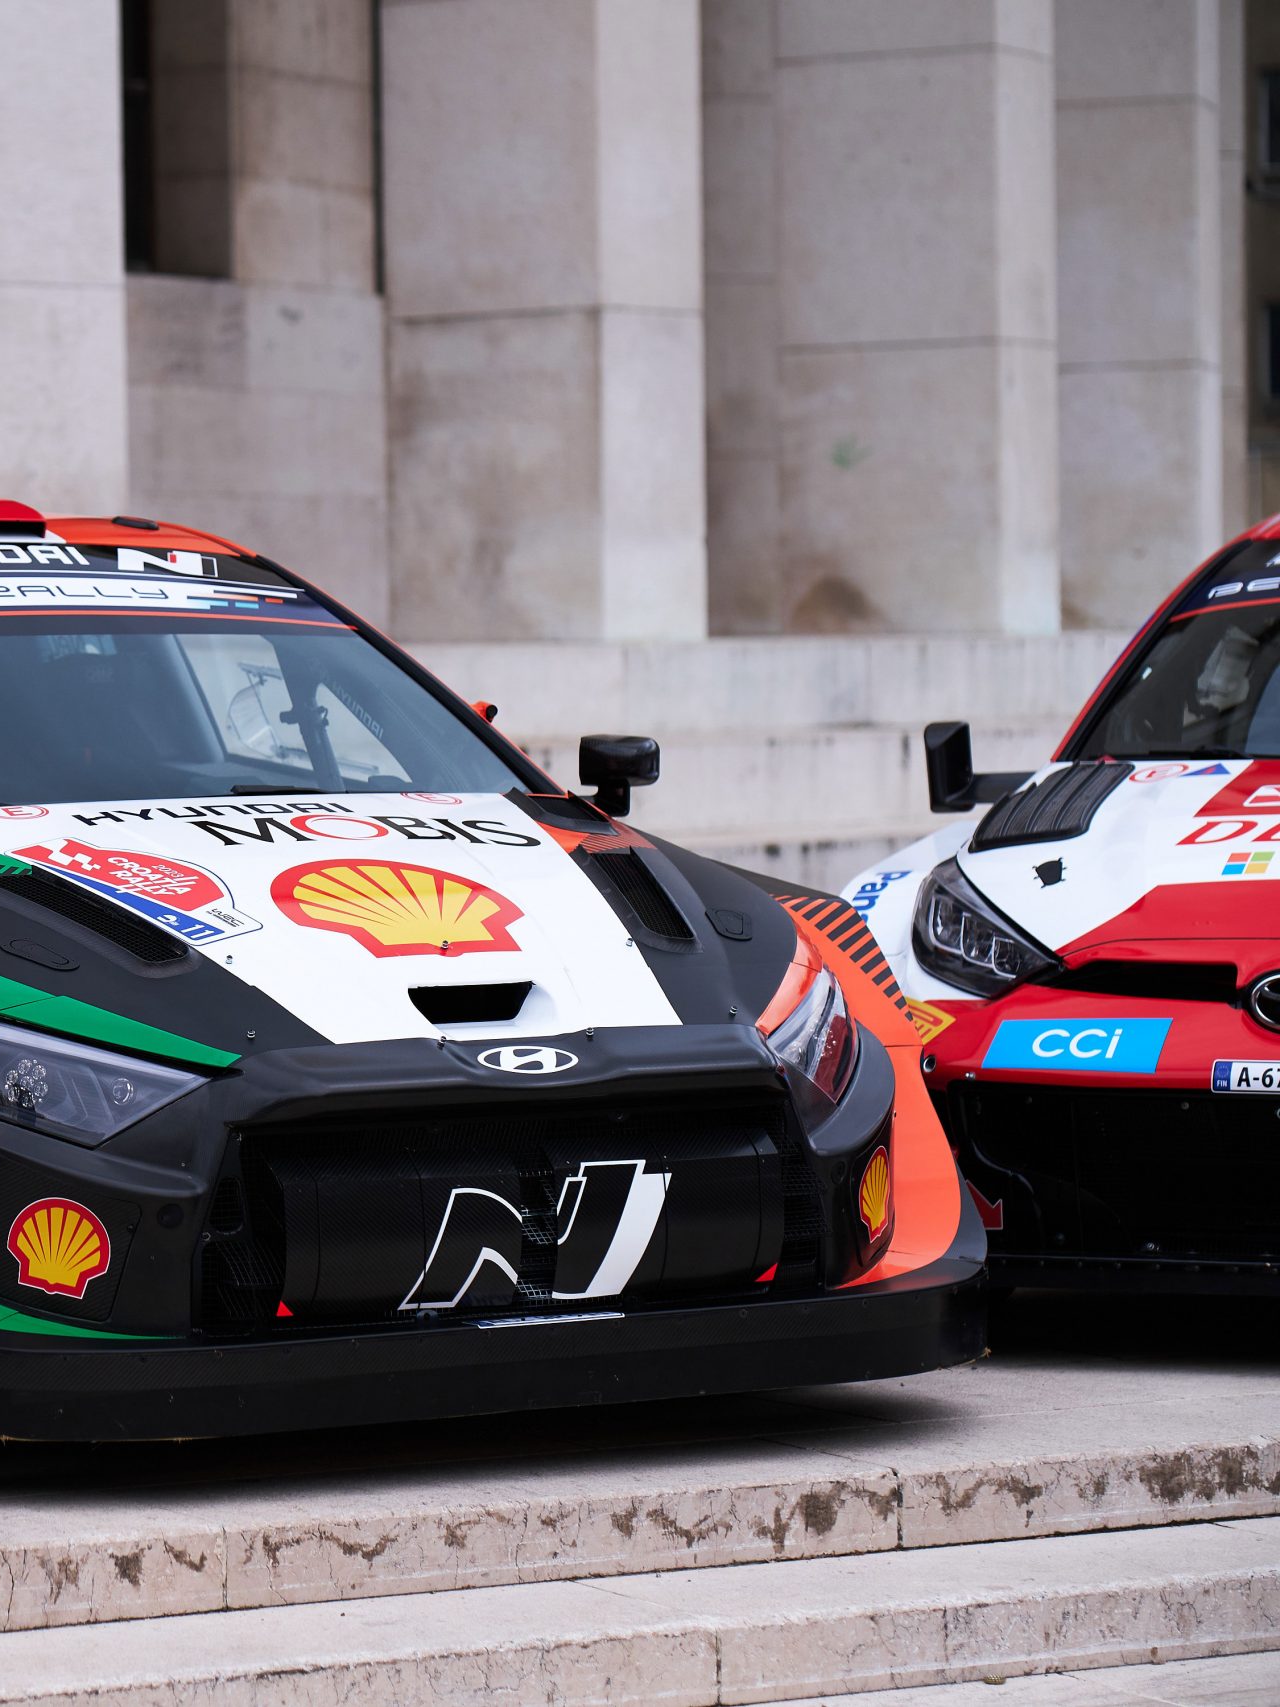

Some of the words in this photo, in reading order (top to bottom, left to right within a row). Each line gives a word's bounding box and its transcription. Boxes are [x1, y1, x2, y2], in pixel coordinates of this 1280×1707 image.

[72, 802, 355, 827] HYUNDAI
[186, 813, 541, 847] MOBIS
[108, 857, 199, 895] CROATIA
[109, 870, 176, 895] RALLY
[181, 924, 214, 939] 11
[1217, 1079, 1228, 1087] FIN
[1236, 1066, 1280, 1088] A-6
